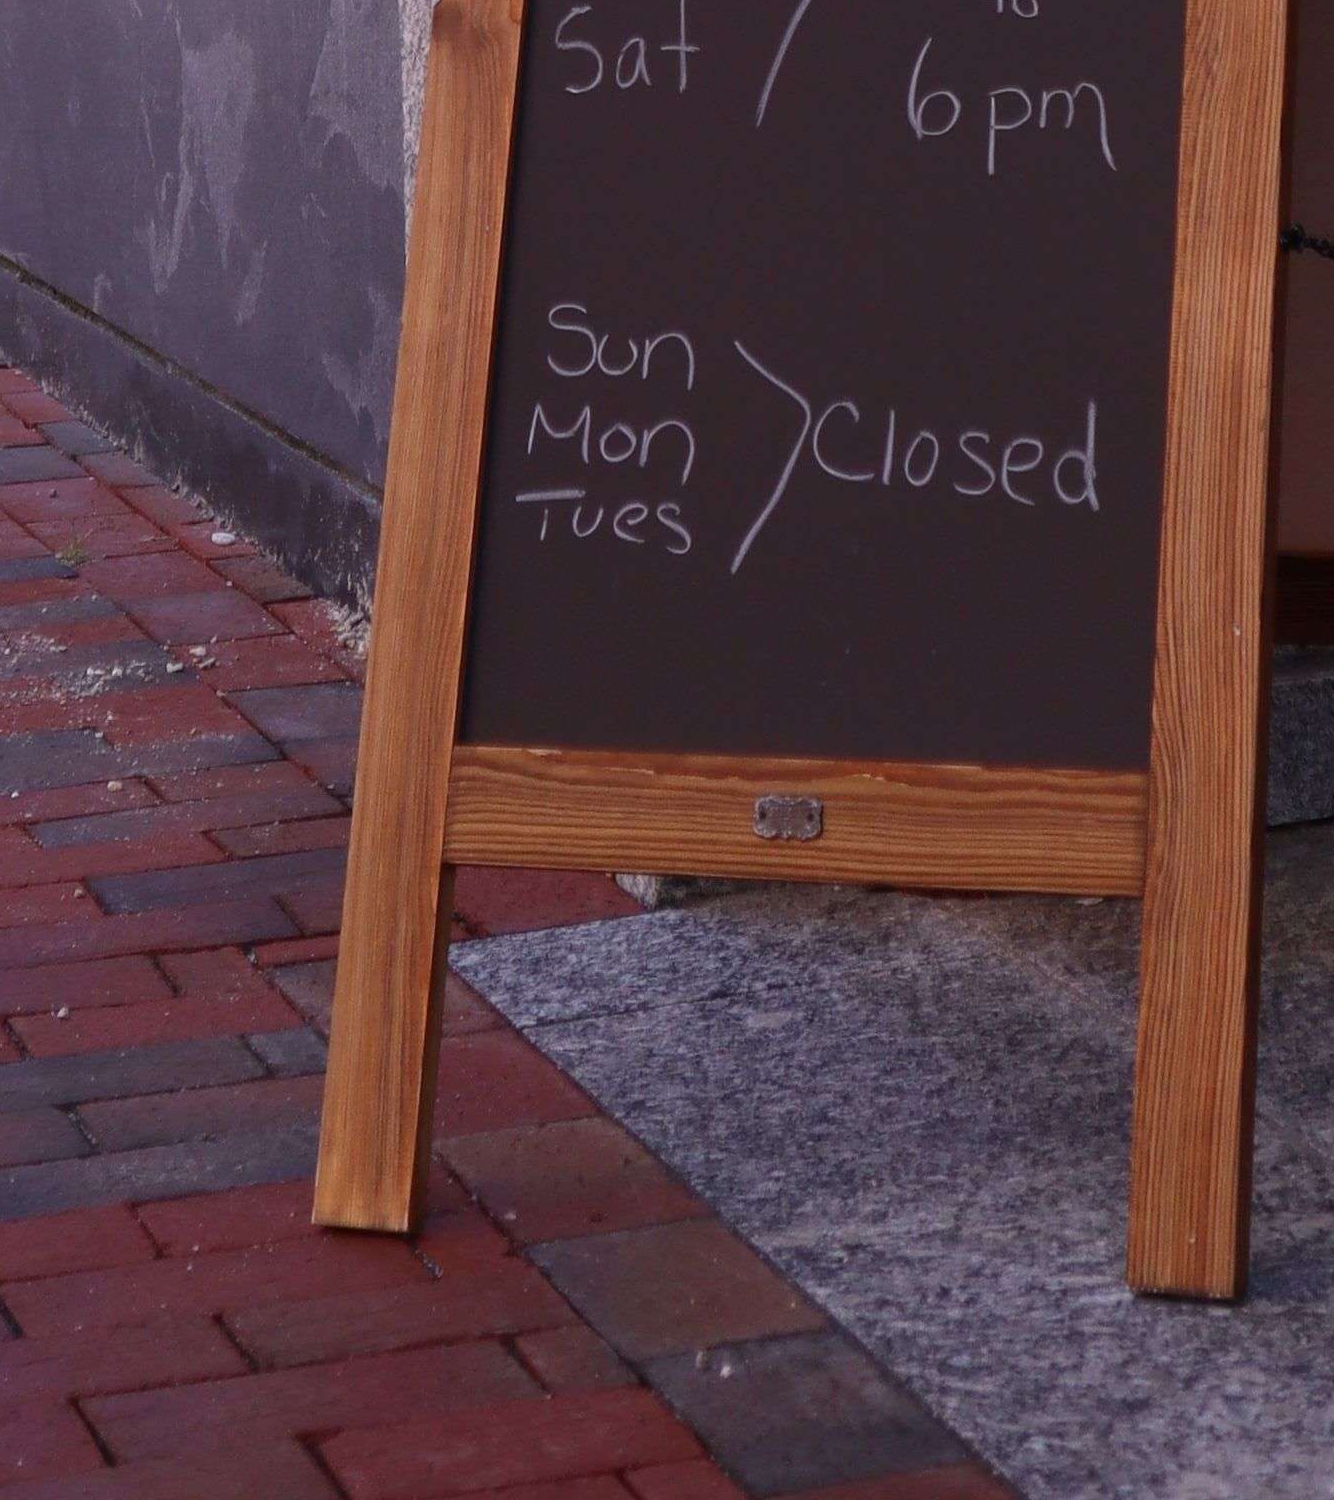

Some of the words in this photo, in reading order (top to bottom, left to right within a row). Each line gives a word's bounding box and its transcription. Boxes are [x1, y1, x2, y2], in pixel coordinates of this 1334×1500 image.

[547, 303, 696, 390] Sun
[527, 403, 696, 485] Mon
[813, 399, 1100, 512] Closed
[515, 488, 692, 555] Tues
